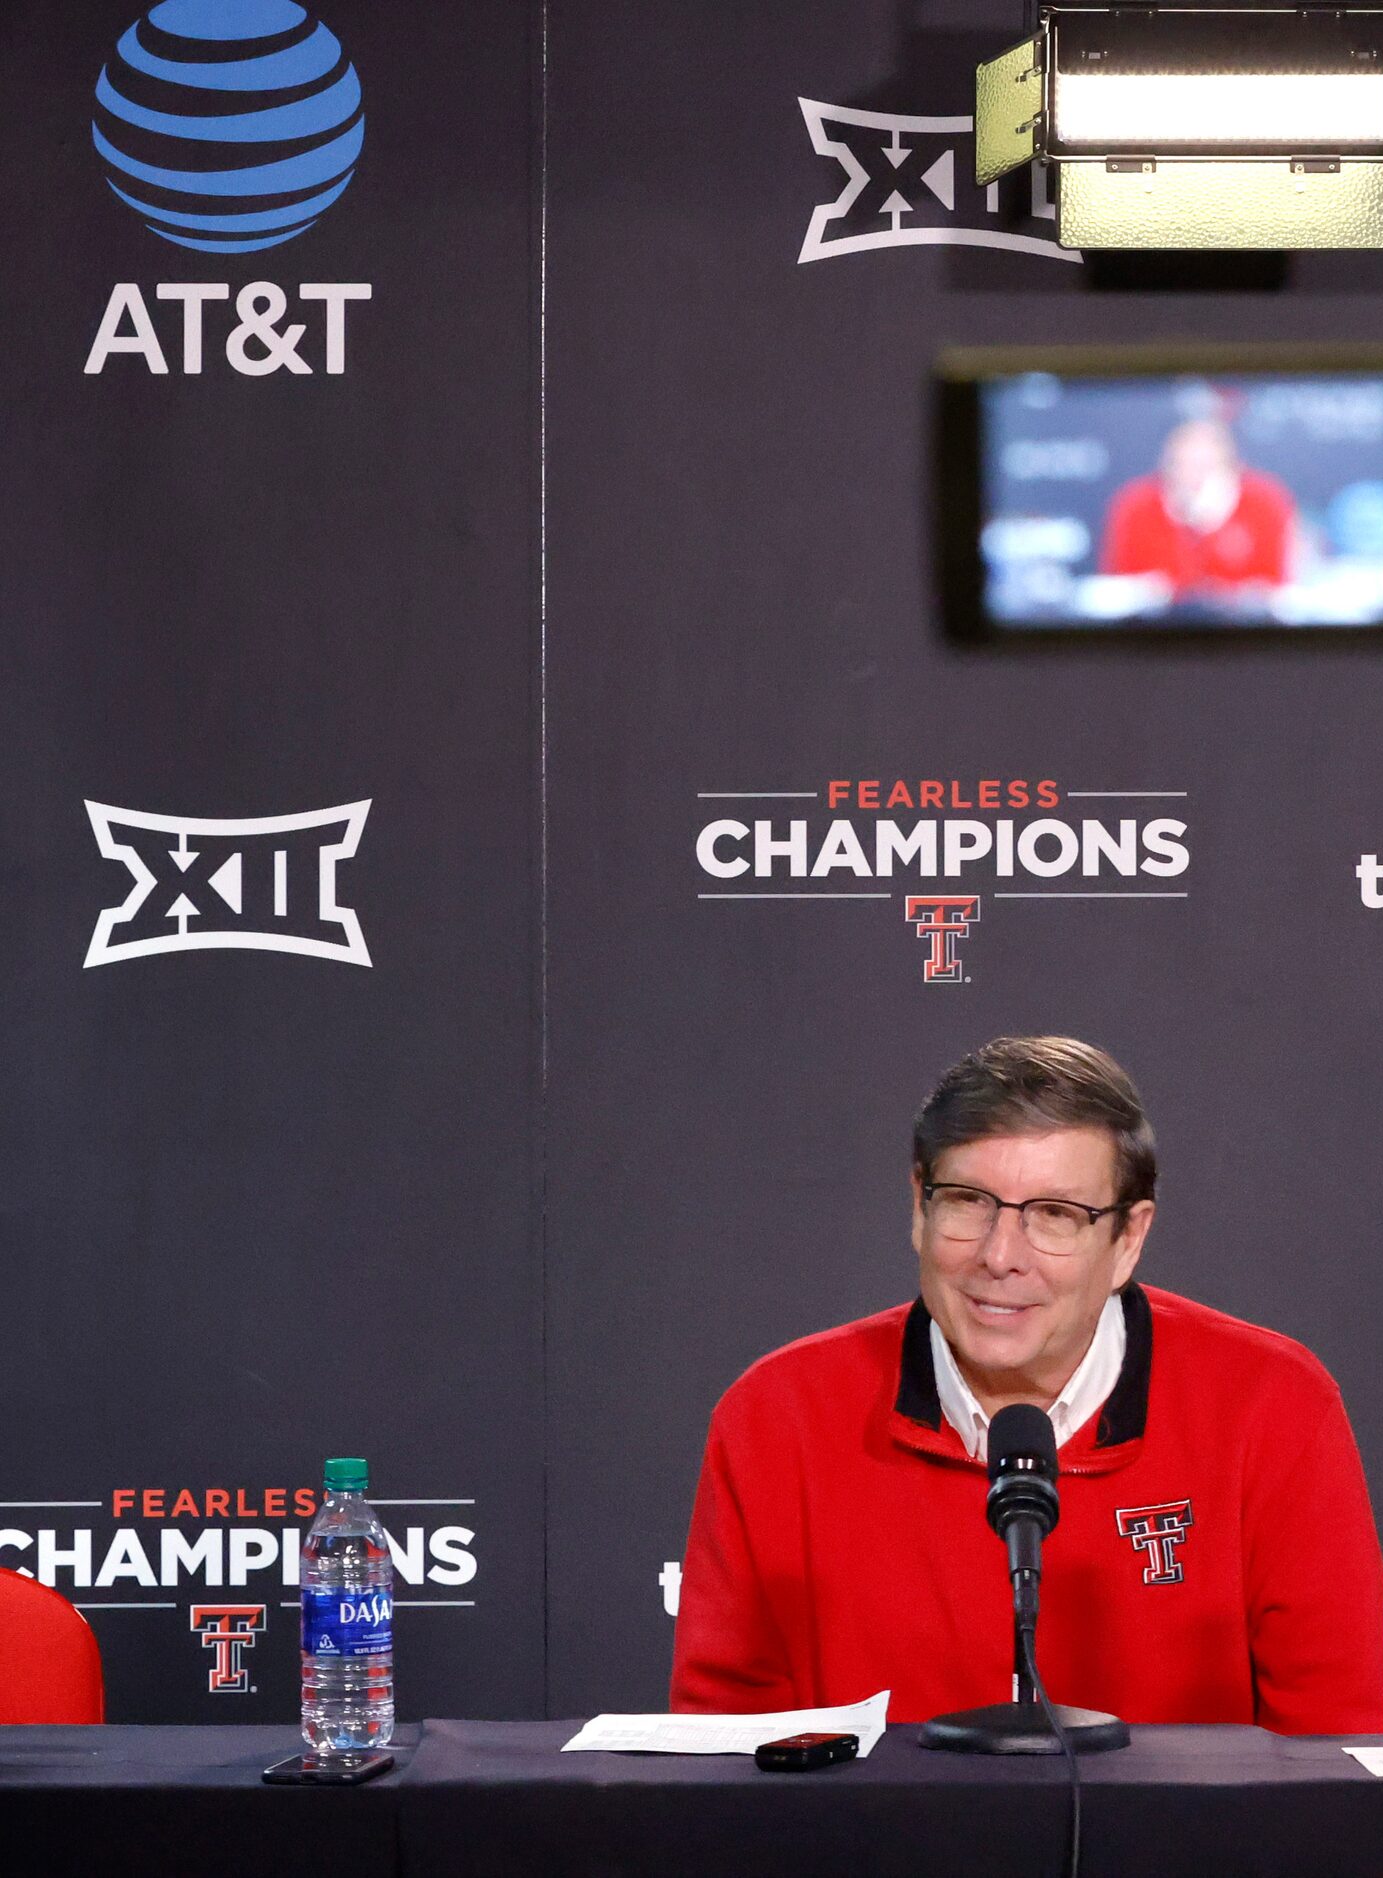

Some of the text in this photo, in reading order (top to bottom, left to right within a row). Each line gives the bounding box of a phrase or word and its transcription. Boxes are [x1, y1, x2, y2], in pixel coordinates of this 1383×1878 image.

[83, 281, 372, 377] AT&T
[828, 779, 1060, 809] FEARLESS
[695, 818, 1190, 879] CHAMPIONS
[112, 1488, 330, 1518] FEARLES
[340, 1594, 393, 1628] DASA
